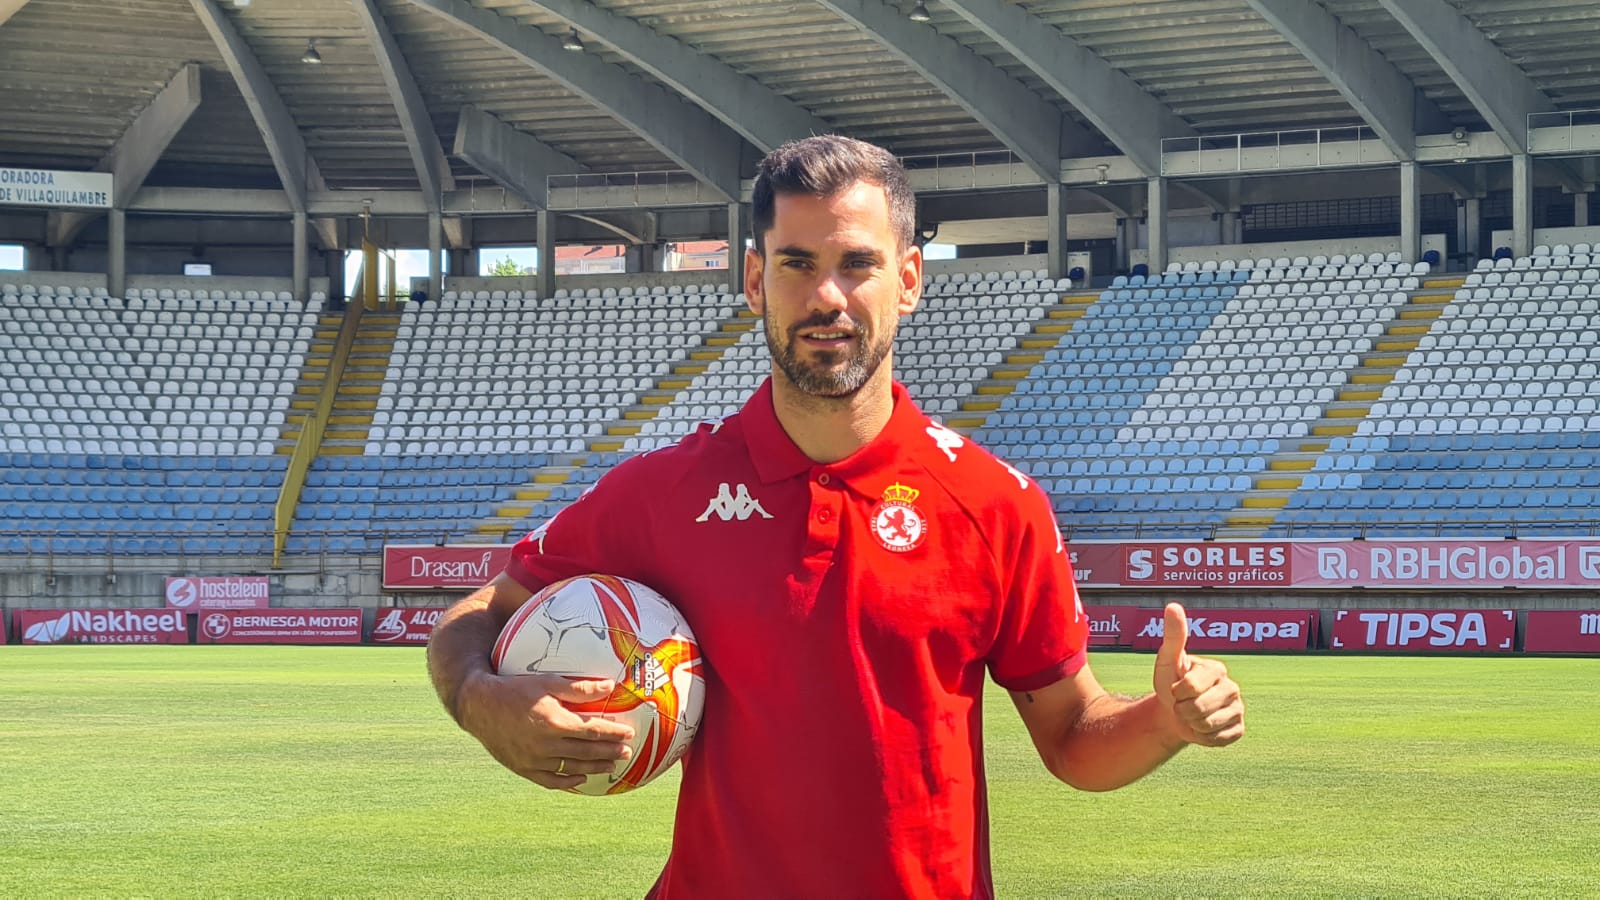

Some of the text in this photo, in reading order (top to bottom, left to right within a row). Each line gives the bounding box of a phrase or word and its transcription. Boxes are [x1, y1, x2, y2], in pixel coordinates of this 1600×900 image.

[16, 188, 107, 205] VILLAQUILAMBRE
[410, 551, 492, 577] Drasanvi
[1163, 547, 1285, 566] SORLES
[1370, 545, 1566, 580] RBHGlobal
[1164, 568, 1284, 583] servicios gráficos
[200, 578, 268, 598] hosteleón
[72, 610, 186, 632] Nakheel
[233, 616, 358, 627] BERNESGA MOTOR
[1188, 618, 1299, 641] Kappa
[1359, 613, 1487, 646] TIPSA
[644, 652, 654, 696] adidas
